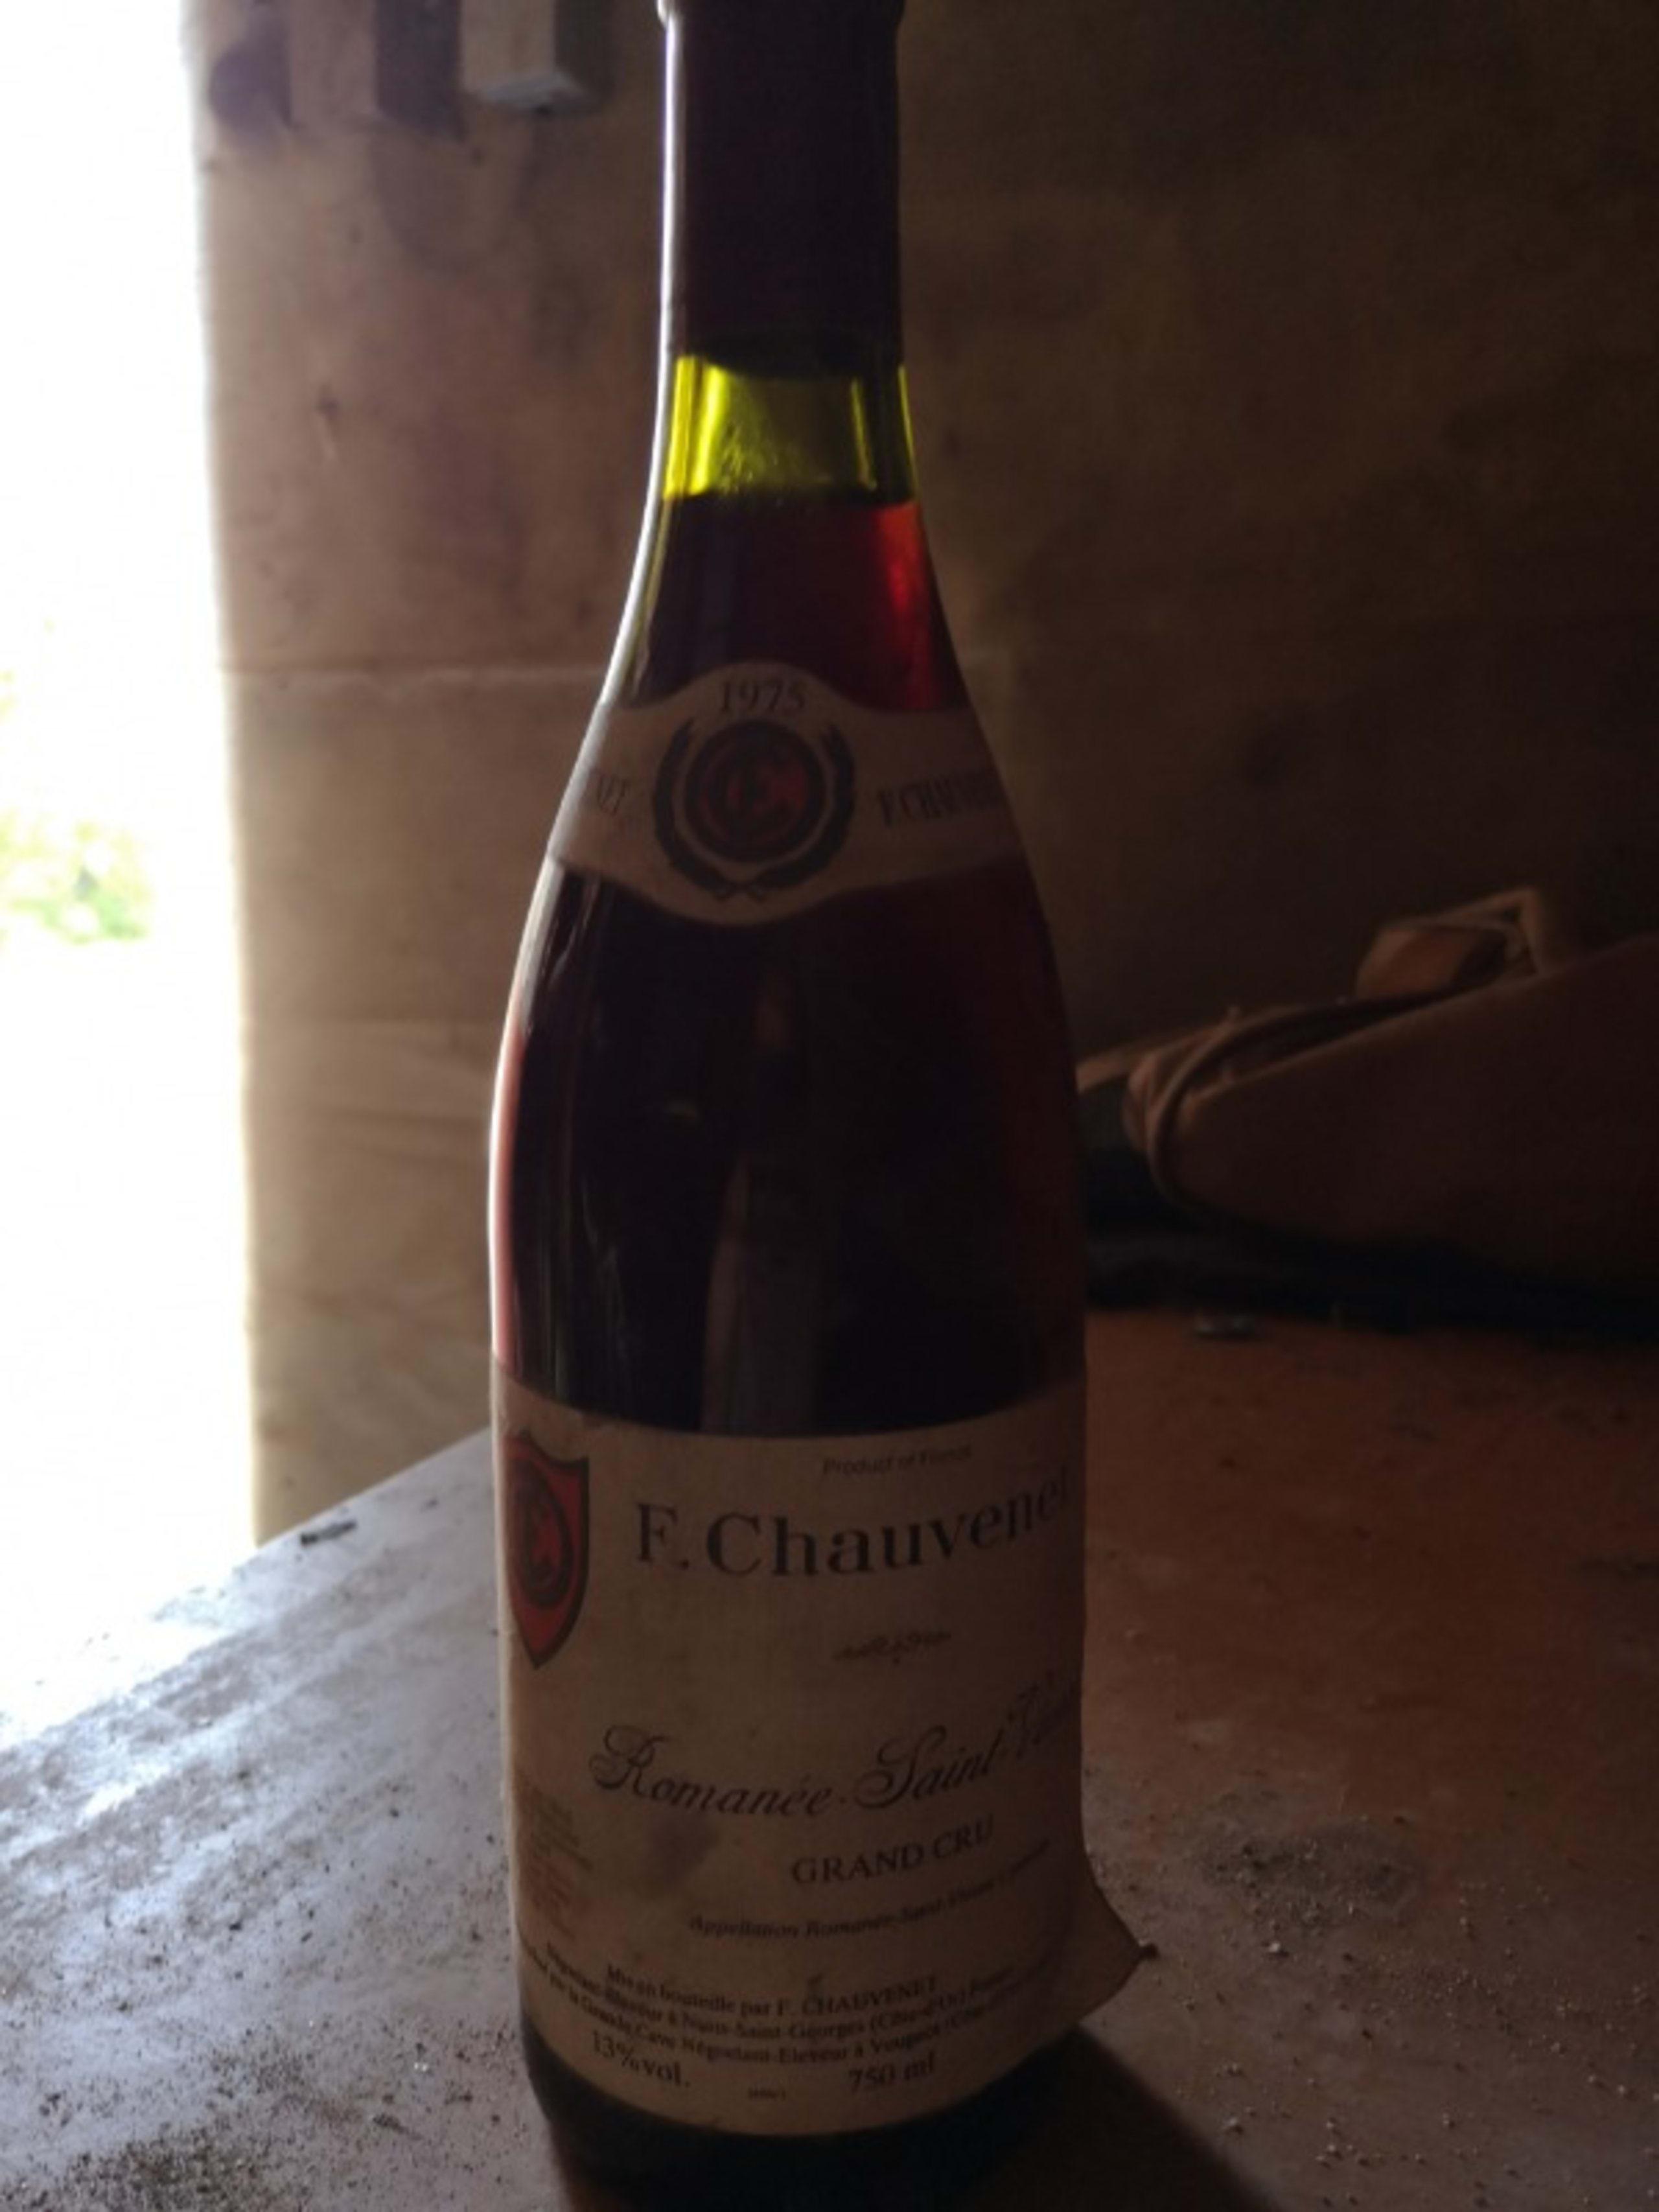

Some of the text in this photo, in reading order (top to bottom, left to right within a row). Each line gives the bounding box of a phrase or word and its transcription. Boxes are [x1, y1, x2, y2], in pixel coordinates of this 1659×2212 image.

[721, 678, 806, 716] 1975
[822, 1455, 892, 1476] Product
[790, 1814, 994, 1885] GRAND CRU
[660, 1983, 736, 2013] bouteille
[740, 1999, 771, 2018] par
[802, 1973, 938, 2016] CHAUVENET
[848, 2049, 937, 2093] 750 ml
